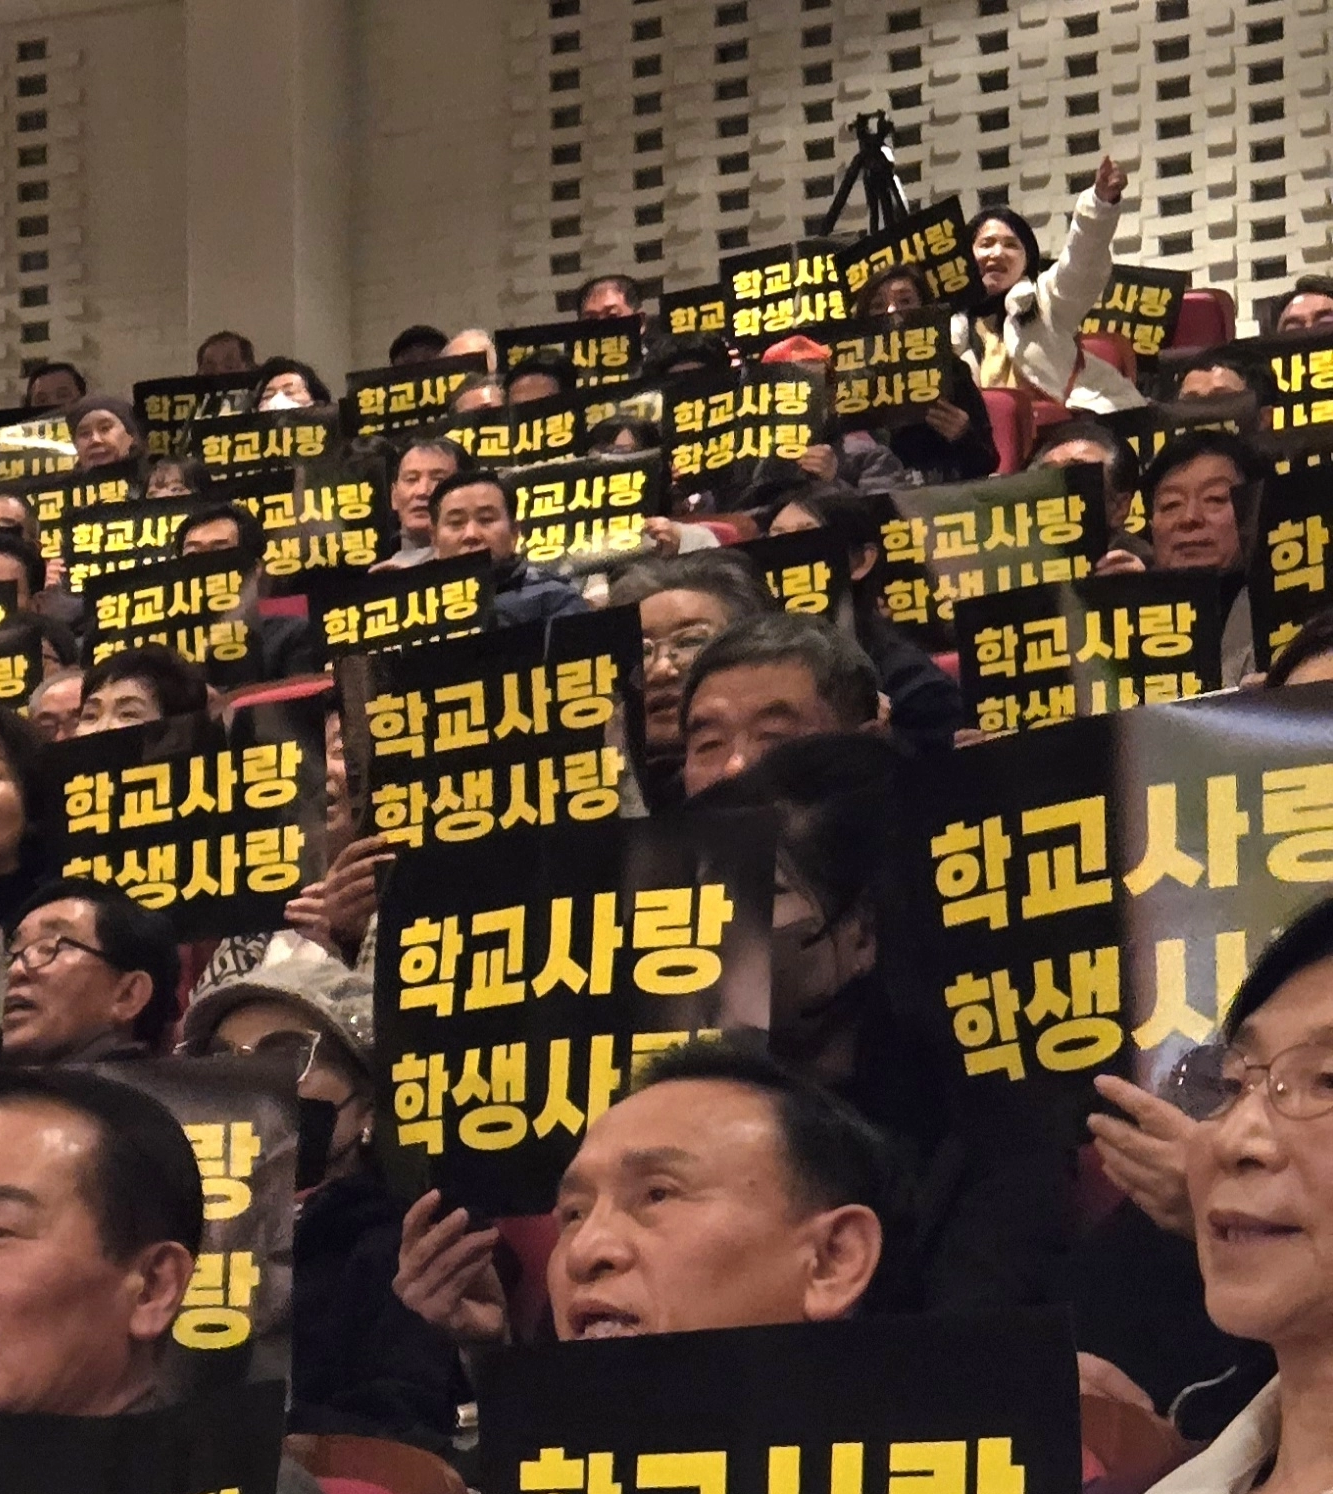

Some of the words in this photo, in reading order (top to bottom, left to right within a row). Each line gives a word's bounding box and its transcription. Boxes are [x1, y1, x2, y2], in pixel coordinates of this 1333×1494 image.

[670, 301, 727, 334] 학교
[833, 328, 939, 371] 교사랑
[673, 382, 811, 433] 학교사랑
[833, 367, 942, 416] 생사랑
[202, 424, 326, 467] 학교사랑
[671, 424, 811, 477] 학생사랑
[236, 483, 373, 530] 교사랑
[881, 496, 1086, 563] 학교사랑
[263, 527, 379, 575] 생사랑
[518, 513, 647, 563] 생사랑
[95, 570, 243, 630] 학교사랑
[323, 577, 480, 644] 학교사랑
[974, 602, 1197, 678] 학교사랑
[366, 654, 618, 759] 학교사랑
[63, 740, 303, 835] 학교사랑
[372, 746, 626, 848] 학생사랑
[398, 885, 734, 1016] 학교사랑
[944, 930, 1258, 1082] 학생사
